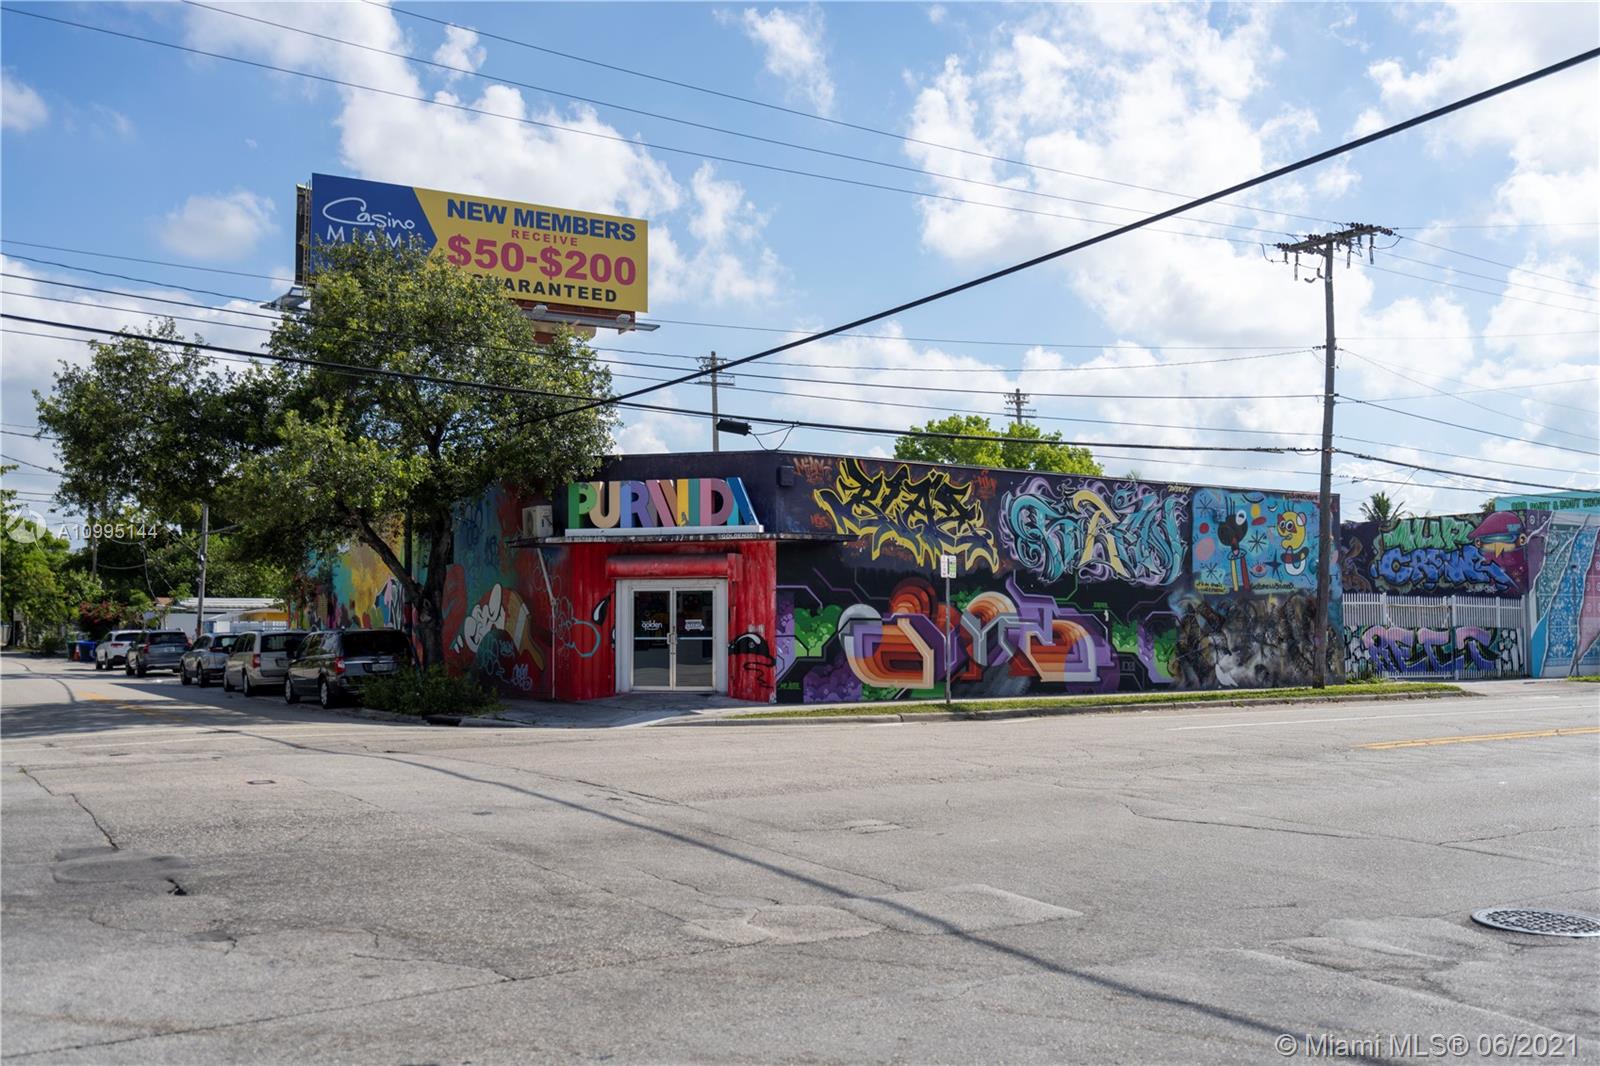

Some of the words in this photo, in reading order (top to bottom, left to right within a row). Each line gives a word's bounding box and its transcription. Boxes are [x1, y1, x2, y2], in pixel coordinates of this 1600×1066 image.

[322, 197, 416, 230] Casino
[447, 199, 507, 224] NEW
[514, 207, 636, 242] MEMBERS
[511, 229, 579, 247] RECEIVE
[447, 233, 637, 286] $50-$200
[473, 273, 617, 303] ARANTEED
